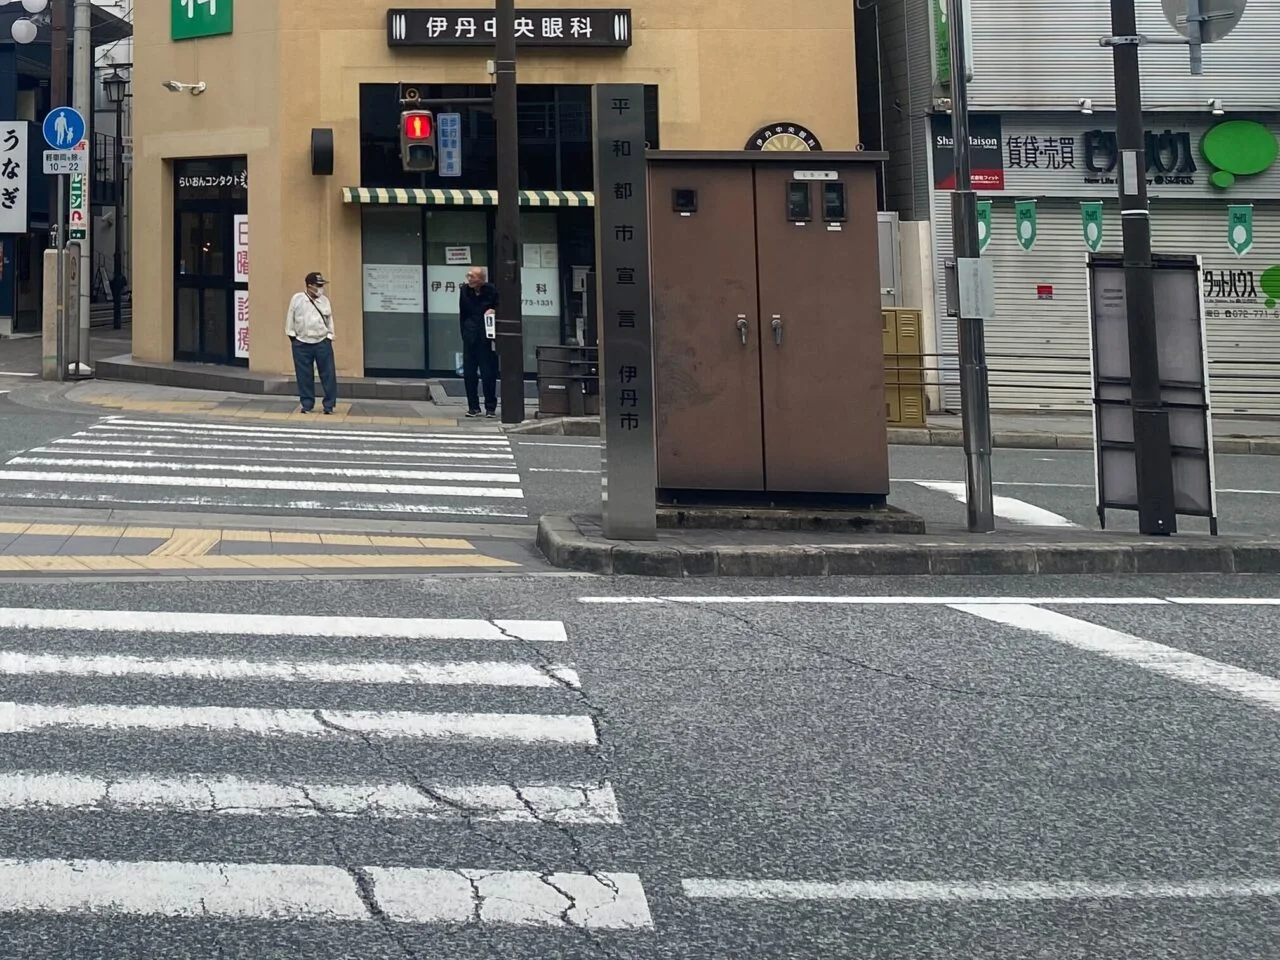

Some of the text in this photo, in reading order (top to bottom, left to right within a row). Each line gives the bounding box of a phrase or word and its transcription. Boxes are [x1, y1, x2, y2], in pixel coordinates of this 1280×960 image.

[426, 16, 593, 38] 伊丹中央眼科
[1, 129, 20, 209] うなぎ
[1007, 136, 1077, 170] 賃貸・売買
[1083, 130, 1197, 173] ピタハウス
[179, 175, 240, 187] らいおんコンタクト
[610, 97, 637, 329] 平和都市宣言
[1202, 269, 1258, 297] タットハウス
[618, 364, 639, 431] 伊丹市
